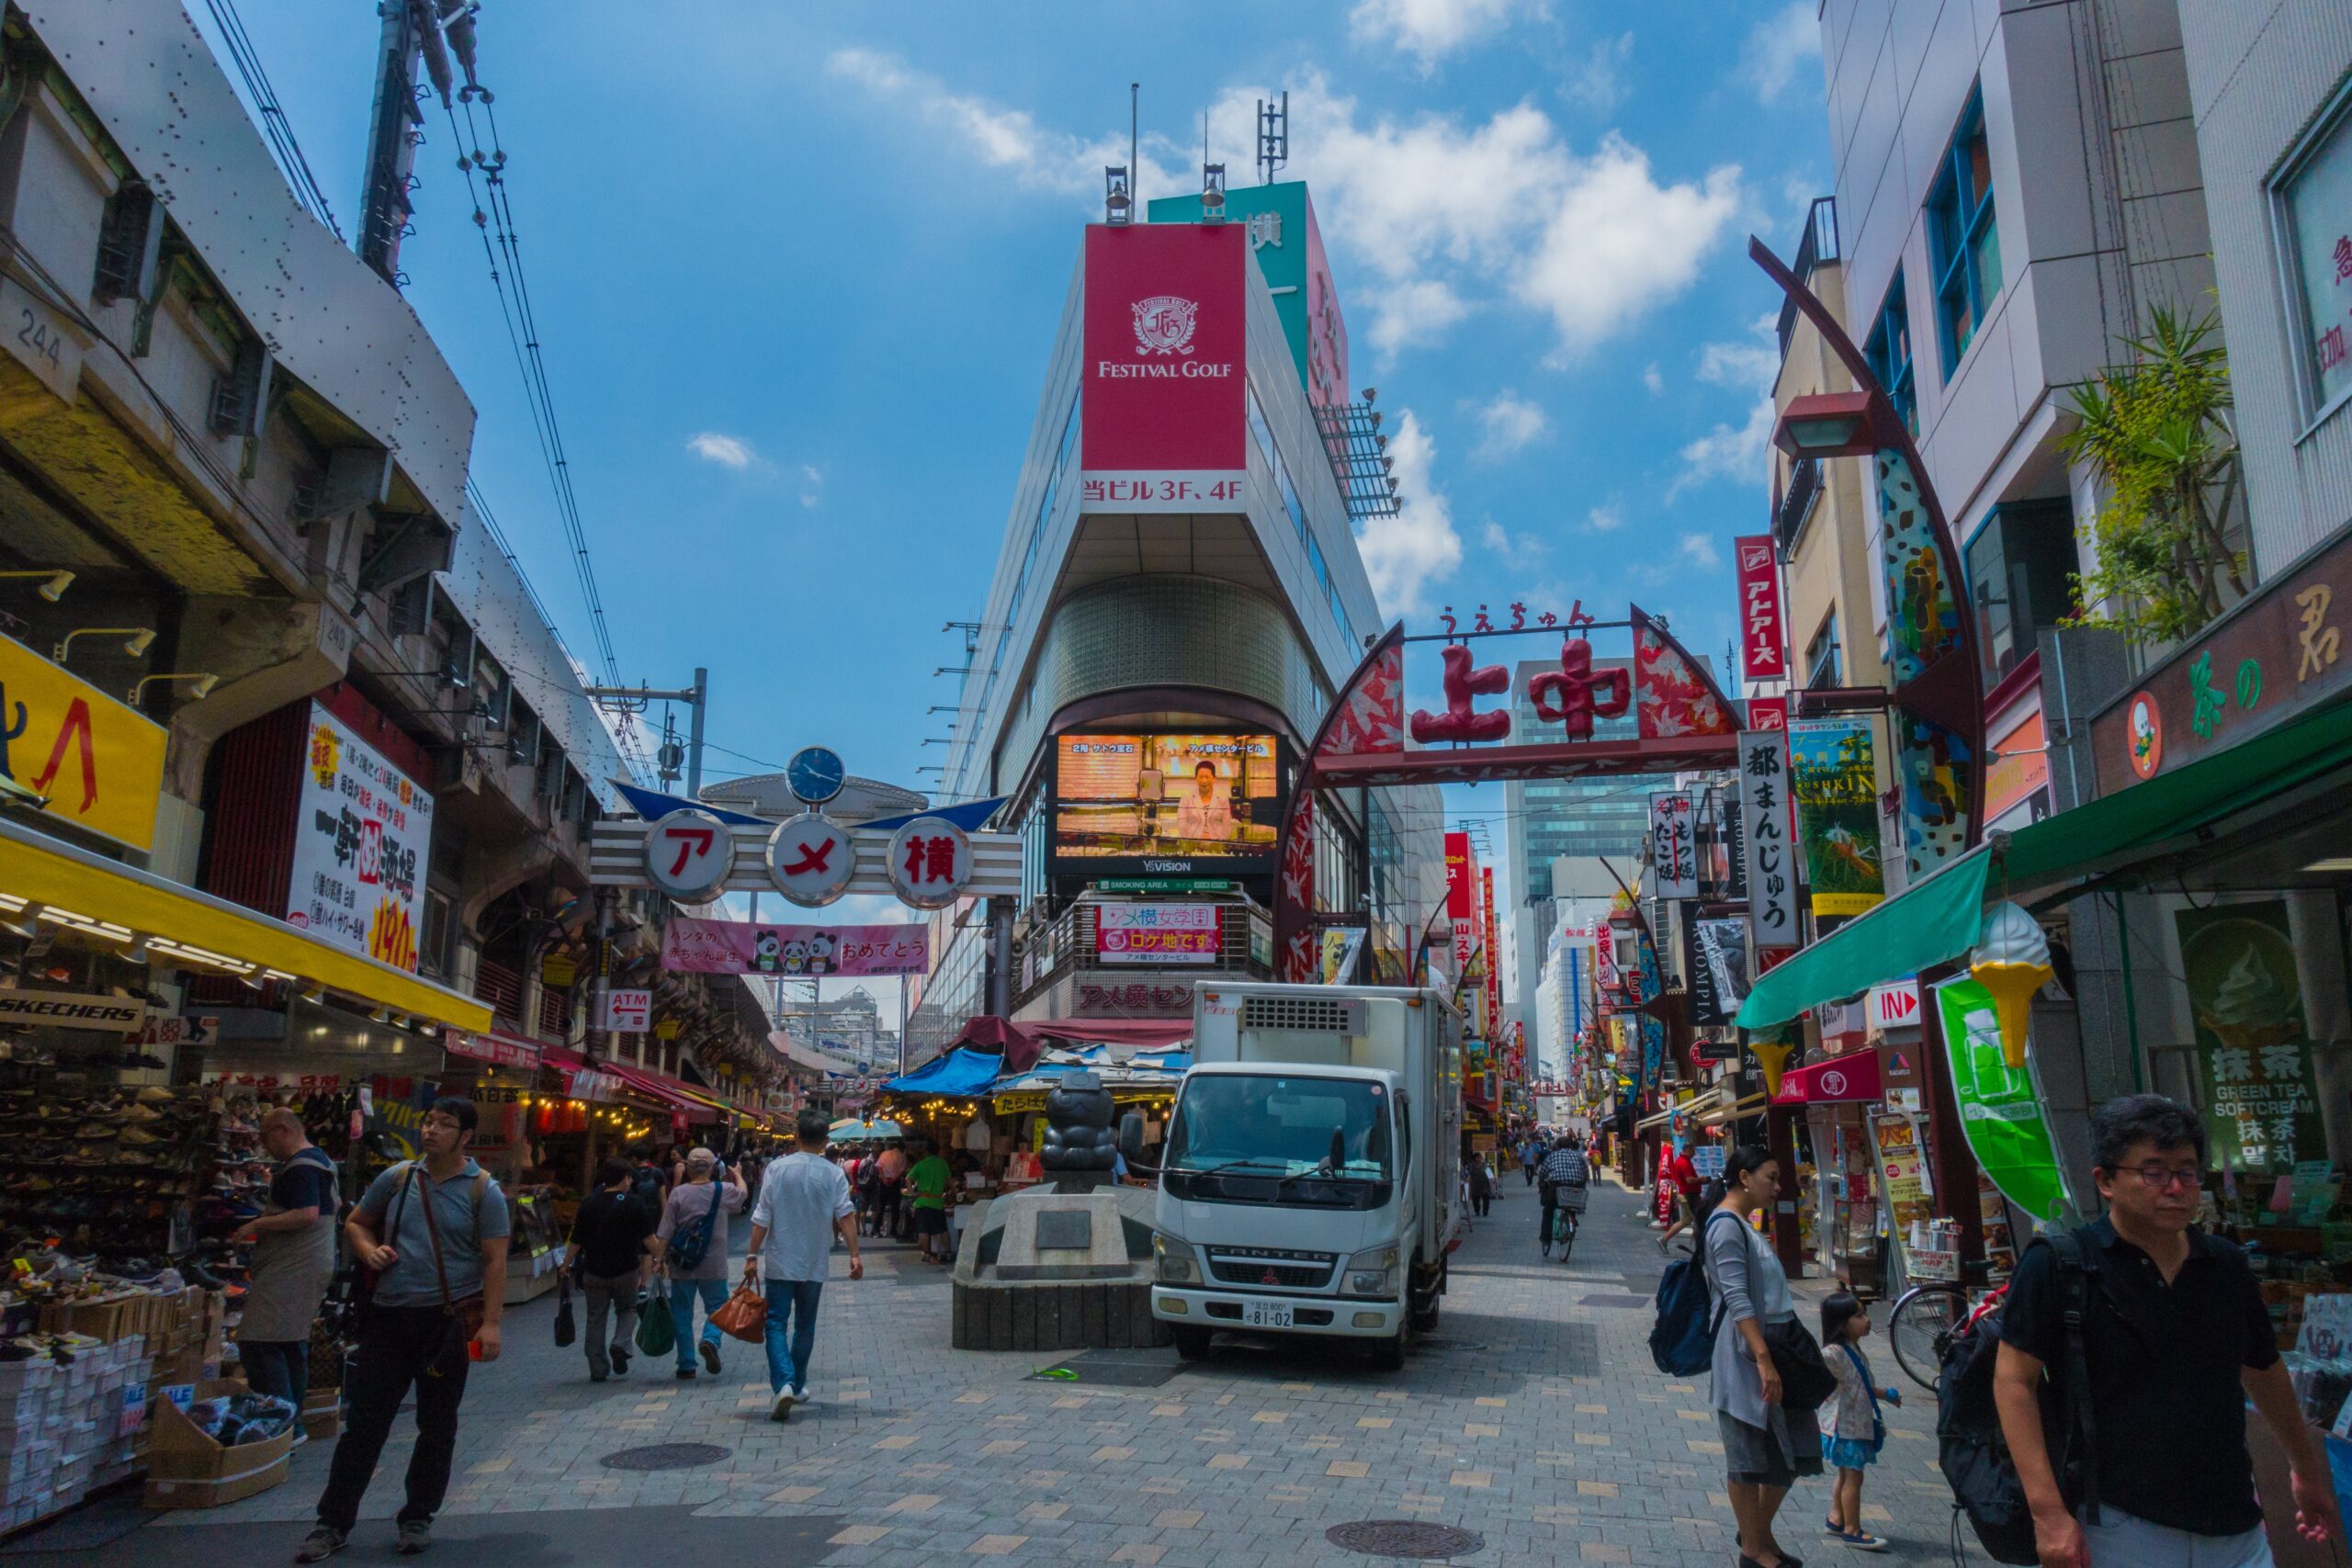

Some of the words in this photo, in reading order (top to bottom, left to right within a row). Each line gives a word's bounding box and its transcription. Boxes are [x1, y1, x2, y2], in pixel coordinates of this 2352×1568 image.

[17, 308, 60, 370] 244
[1098, 361, 1180, 378] FESTIVAL
[1182, 361, 1231, 378] GOLF
[1410, 638, 1631, 745] 上中
[1747, 745, 1785, 930] 都まんじゅう
[665, 828, 955, 884] アメ横
[1109, 908, 1209, 927] アメ横女学園
[670, 930, 717, 944] パンダの
[1130, 934, 1209, 950] ロケ地です
[669, 946, 740, 964] 赤ちゃん誕生
[842, 942, 926, 959] おめでとう
[1125, 953, 1190, 962] アメ横センタービル
[613, 994, 648, 1005] ATM
[1881, 990, 1904, 1021] IN
[0, 998, 137, 1021] SKECHERS
[2211, 1045, 2302, 1082] 抹茶
[2216, 1084, 2271, 1100] GREEN
[2274, 1083, 2308, 1098] TEA
[2214, 1100, 2314, 1117] SOFTCREAM
[1210, 1247, 1331, 1261] CANTER
[1253, 1311, 1291, 1327] 81-02
